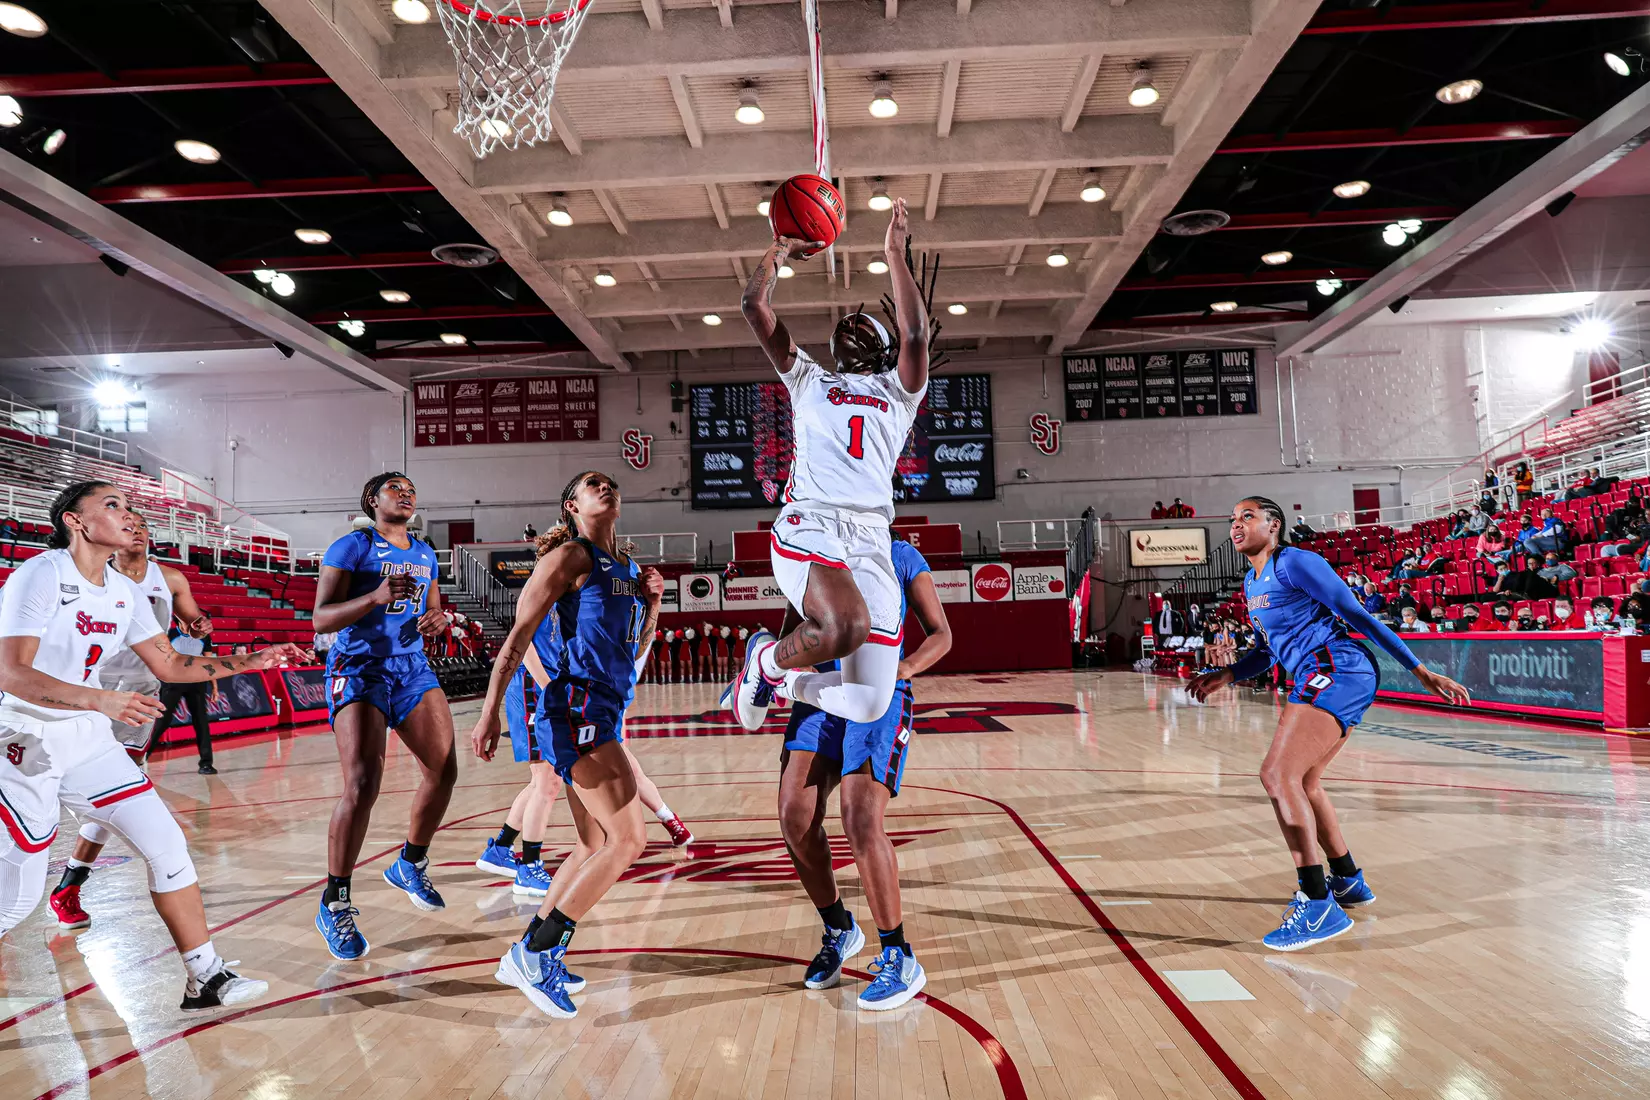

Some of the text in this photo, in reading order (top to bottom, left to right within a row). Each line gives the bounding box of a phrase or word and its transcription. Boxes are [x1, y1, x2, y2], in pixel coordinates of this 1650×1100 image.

[1067, 358, 1097, 373] NCAA
[1105, 357, 1136, 372] NCAA
[1146, 359, 1173, 367] EAST
[1105, 379, 1138, 388] APPEARANCES
[1145, 378, 1175, 386] CHAMPIONS
[1184, 376, 1214, 384] CHAMPIONS
[493, 387, 520, 395] EAST
[528, 380, 557, 395] NCAA
[566, 379, 595, 394] NCAA
[417, 384, 446, 400] WNIT
[456, 388, 484, 396] EAST
[527, 403, 560, 411] APPEARANCES
[565, 401, 596, 411] SWEET 16
[1076, 399, 1093, 409] 2007
[416, 408, 448, 416] APPEARANCES
[455, 407, 484, 415] CHAMPIONS
[492, 406, 521, 414] CHAMPIONS
[573, 420, 589, 429] 2012
[847, 414, 865, 460] 1
[1016, 572, 1049, 584] Apple
[934, 581, 967, 589] resbyterian
[1016, 584, 1046, 595] Bank
[625, 603, 646, 643] 11
[1489, 646, 1570, 687] protiviti
